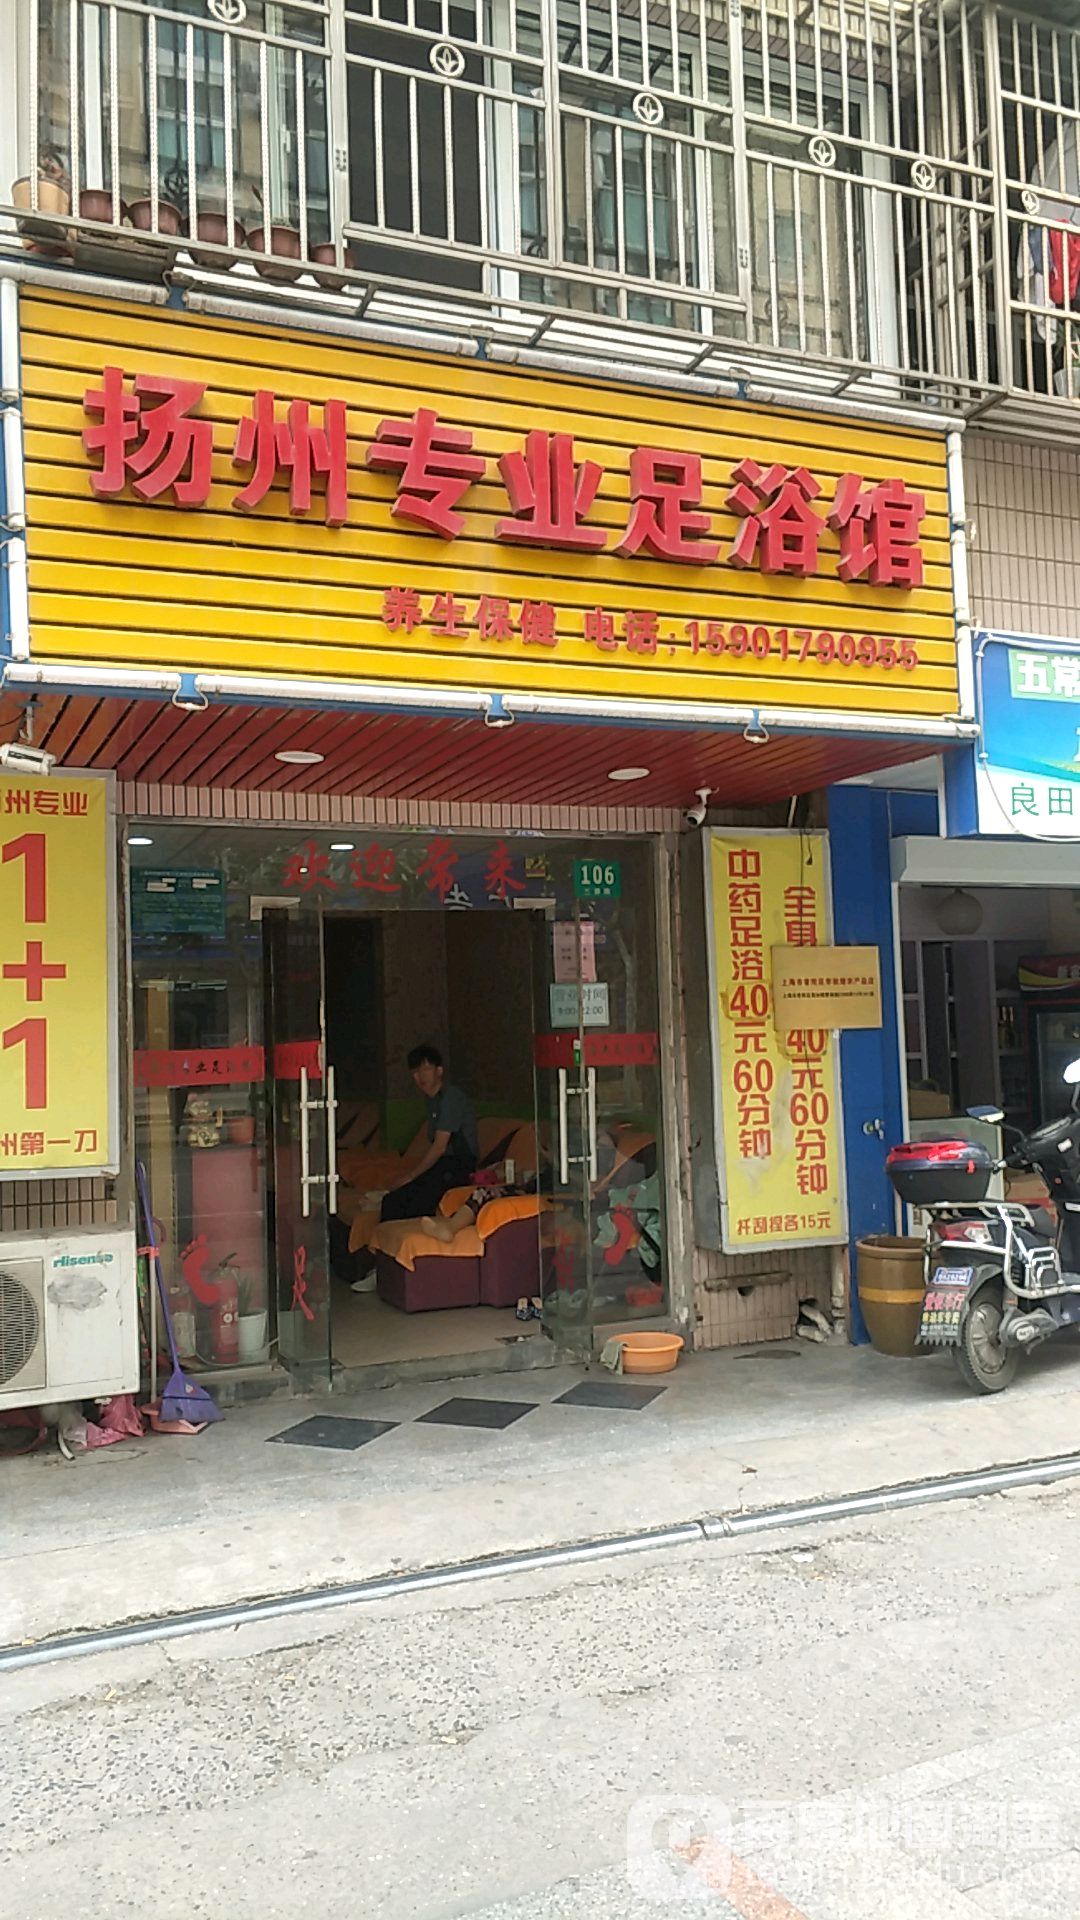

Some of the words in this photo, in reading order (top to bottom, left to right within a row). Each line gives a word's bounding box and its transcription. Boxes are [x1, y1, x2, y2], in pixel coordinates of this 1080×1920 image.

[82, 367, 926, 588] 扬州专业足浴馆
[382, 586, 559, 646] 养生保健
[1016, 653, 1080, 698] 五常
[4, 789, 88, 816] 州专业
[1011, 782, 1073, 815] 良田
[281, 836, 526, 904] 欢迎常来
[581, 865, 615, 885] 106
